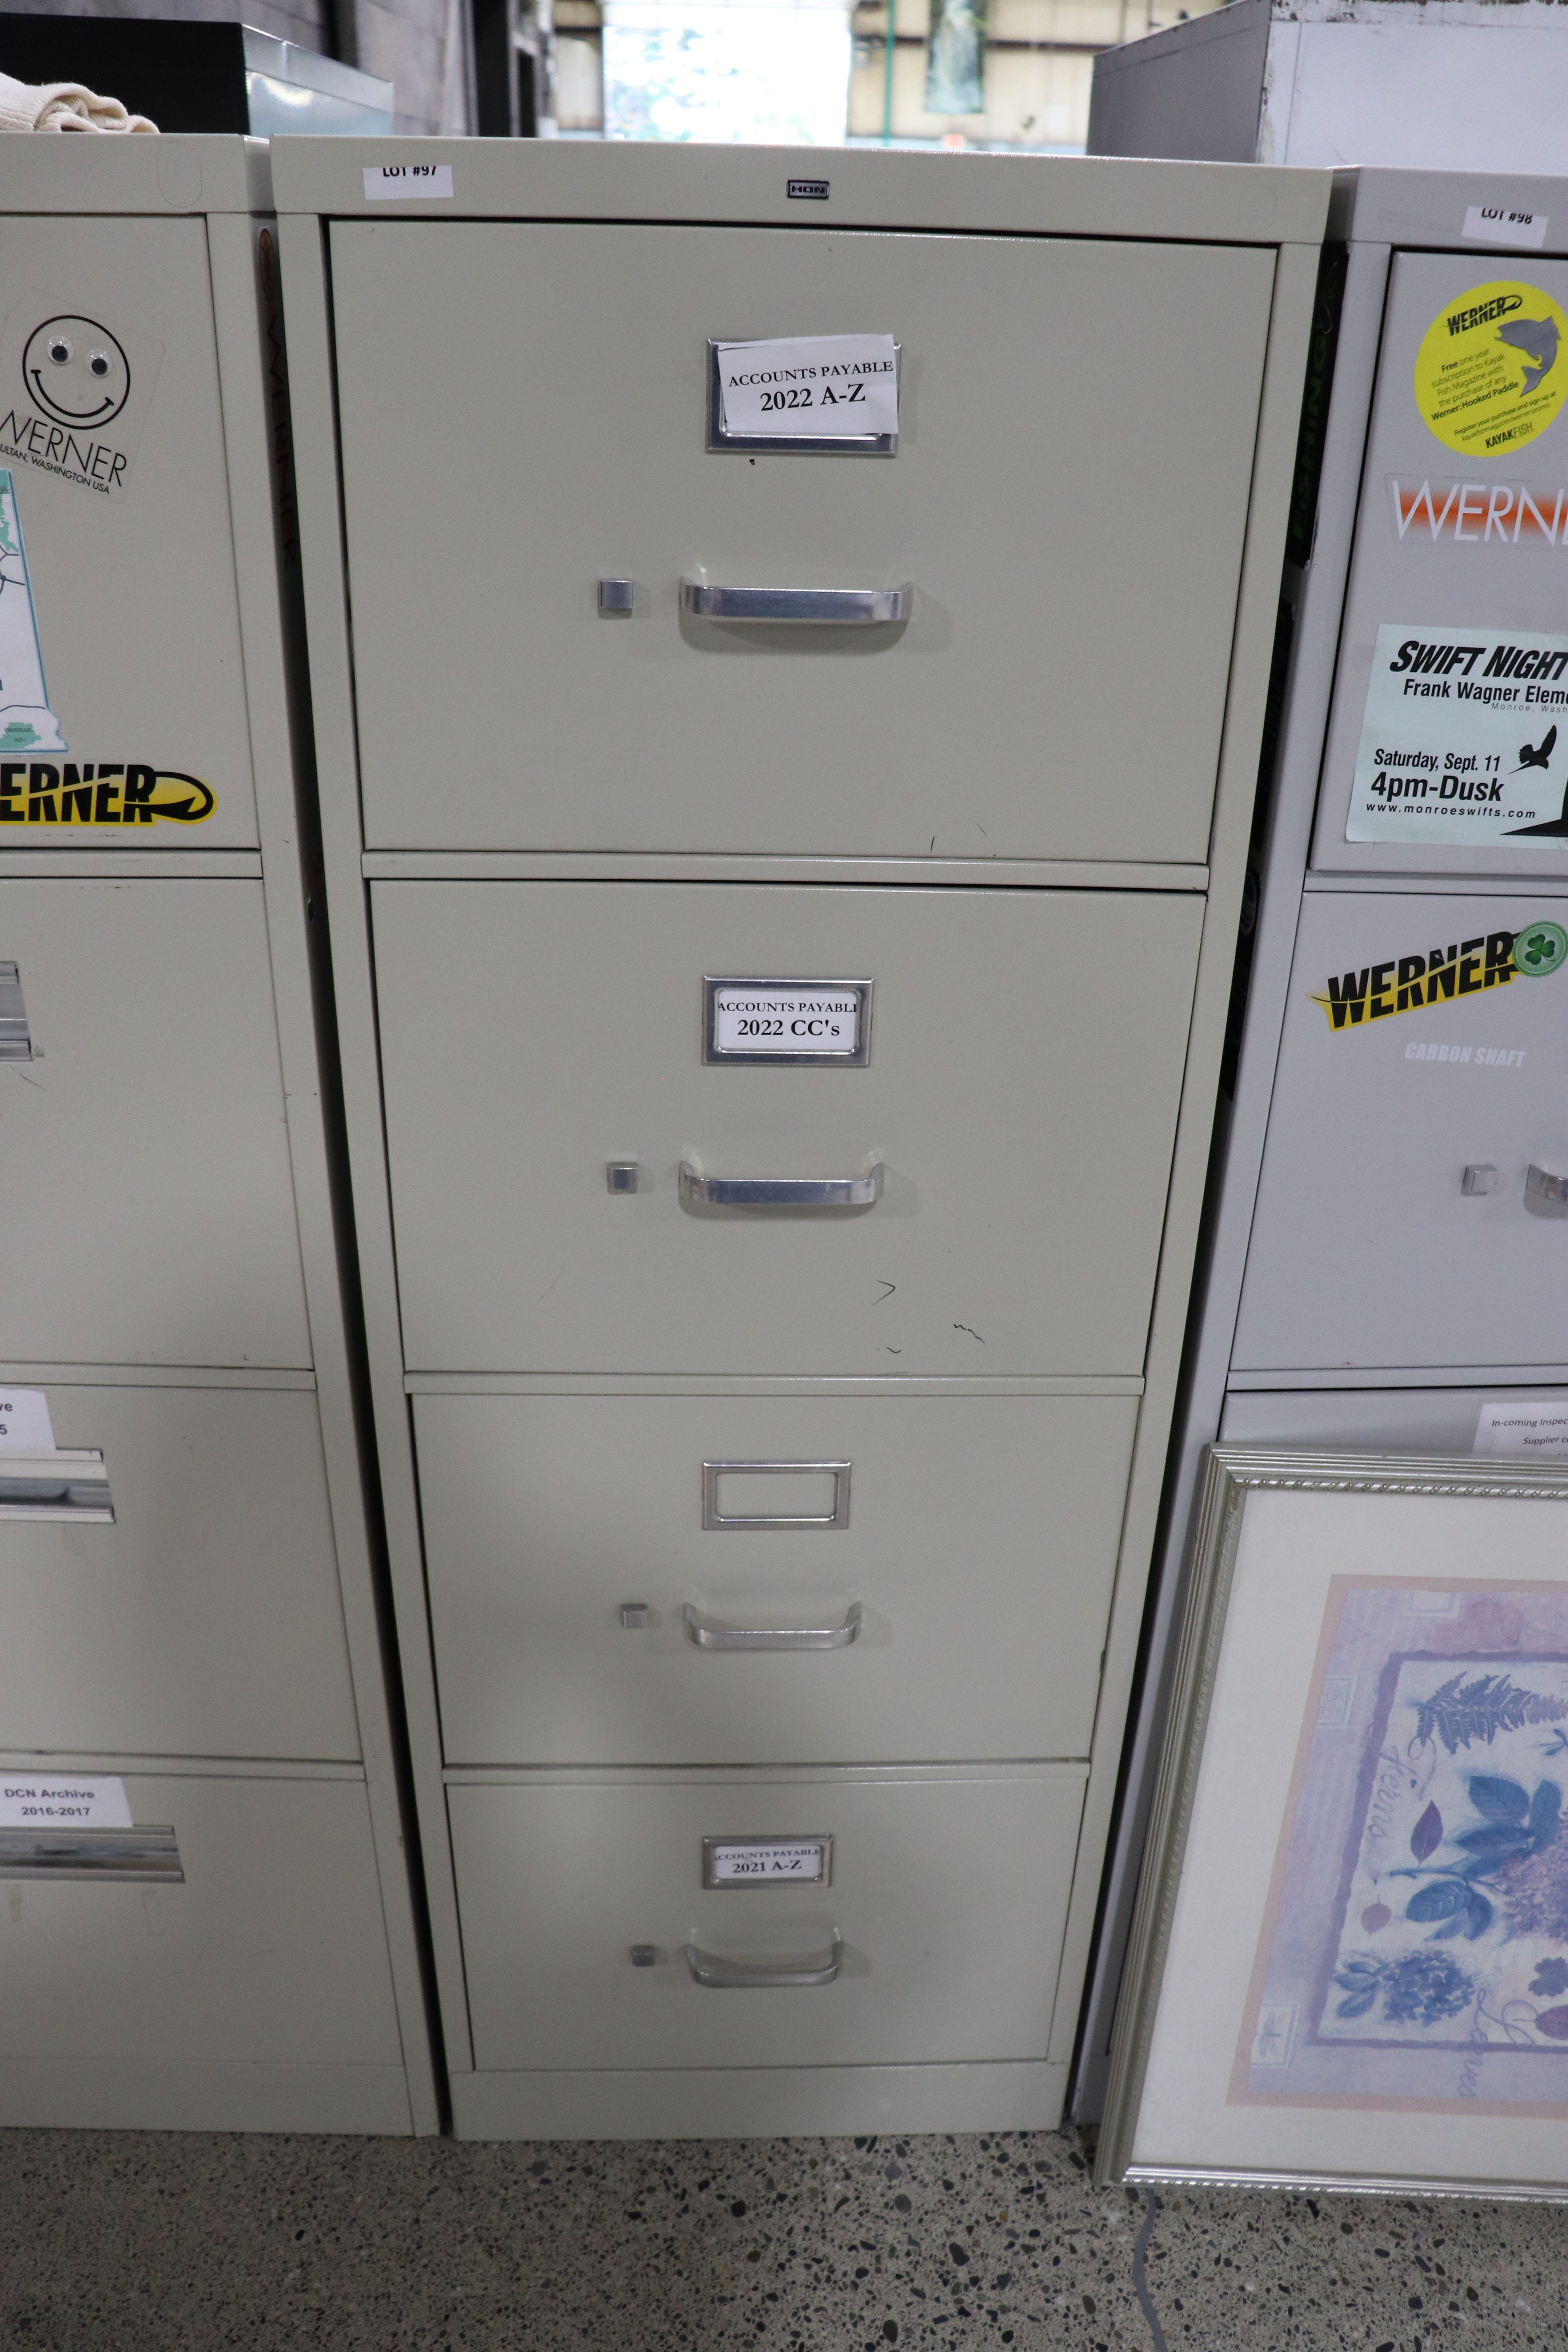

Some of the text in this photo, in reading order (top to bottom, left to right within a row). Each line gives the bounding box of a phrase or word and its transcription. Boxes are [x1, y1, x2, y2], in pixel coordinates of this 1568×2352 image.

[383, 166, 437, 177] LOT #97
[1481, 207, 1533, 224] LOT #98
[1447, 296, 1507, 336] WERNER
[1432, 366, 1475, 388] subscription
[1484, 352, 1504, 367] Kayak
[1441, 348, 1489, 372] Free one year
[728, 361, 894, 387] ACCOUNTS PAYABLE
[1437, 365, 1504, 396] Fish Magazine with
[760, 383, 866, 412] 2022 A-Z
[1439, 375, 1506, 407] the purchase of any
[1492, 381, 1519, 396] Paddle
[1454, 423, 1477, 436] Register
[1478, 418, 1490, 427] your
[1491, 407, 1516, 422] purchase
[1517, 402, 1528, 411] and
[1529, 397, 1541, 406] sign
[0, 443, 110, 495] ULTAN, WASHINGTON USA
[1392, 479, 1568, 548] WERN
[1389, 640, 1487, 675] SWIFT
[1403, 679, 1452, 698] Frank
[1457, 681, 1520, 704] Wagner
[1491, 702, 1535, 712] Monroe,
[1374, 748, 1501, 774] Saturday, Sept. 11
[1371, 771, 1504, 802] 4pm-Dusk
[1366, 803, 1536, 818] www.monroeswifts.com
[1327, 931, 1514, 1029] WERNER
[719, 1002, 795, 1012] ACCOUNTS
[738, 1019, 840, 1036] 2022 CC's
[1405, 1042, 1527, 1068] CARBON SHAFT
[1492, 1419, 1537, 1428] In-coming
[1523, 1436, 1559, 1446] Supplier
[4, 1789, 94, 1798] DCN Archive
[22, 1807, 91, 1816] 2016-2017
[715, 1851, 771, 1860] CCOUNTS
[732, 1859, 802, 1873] 2021 A-Z
